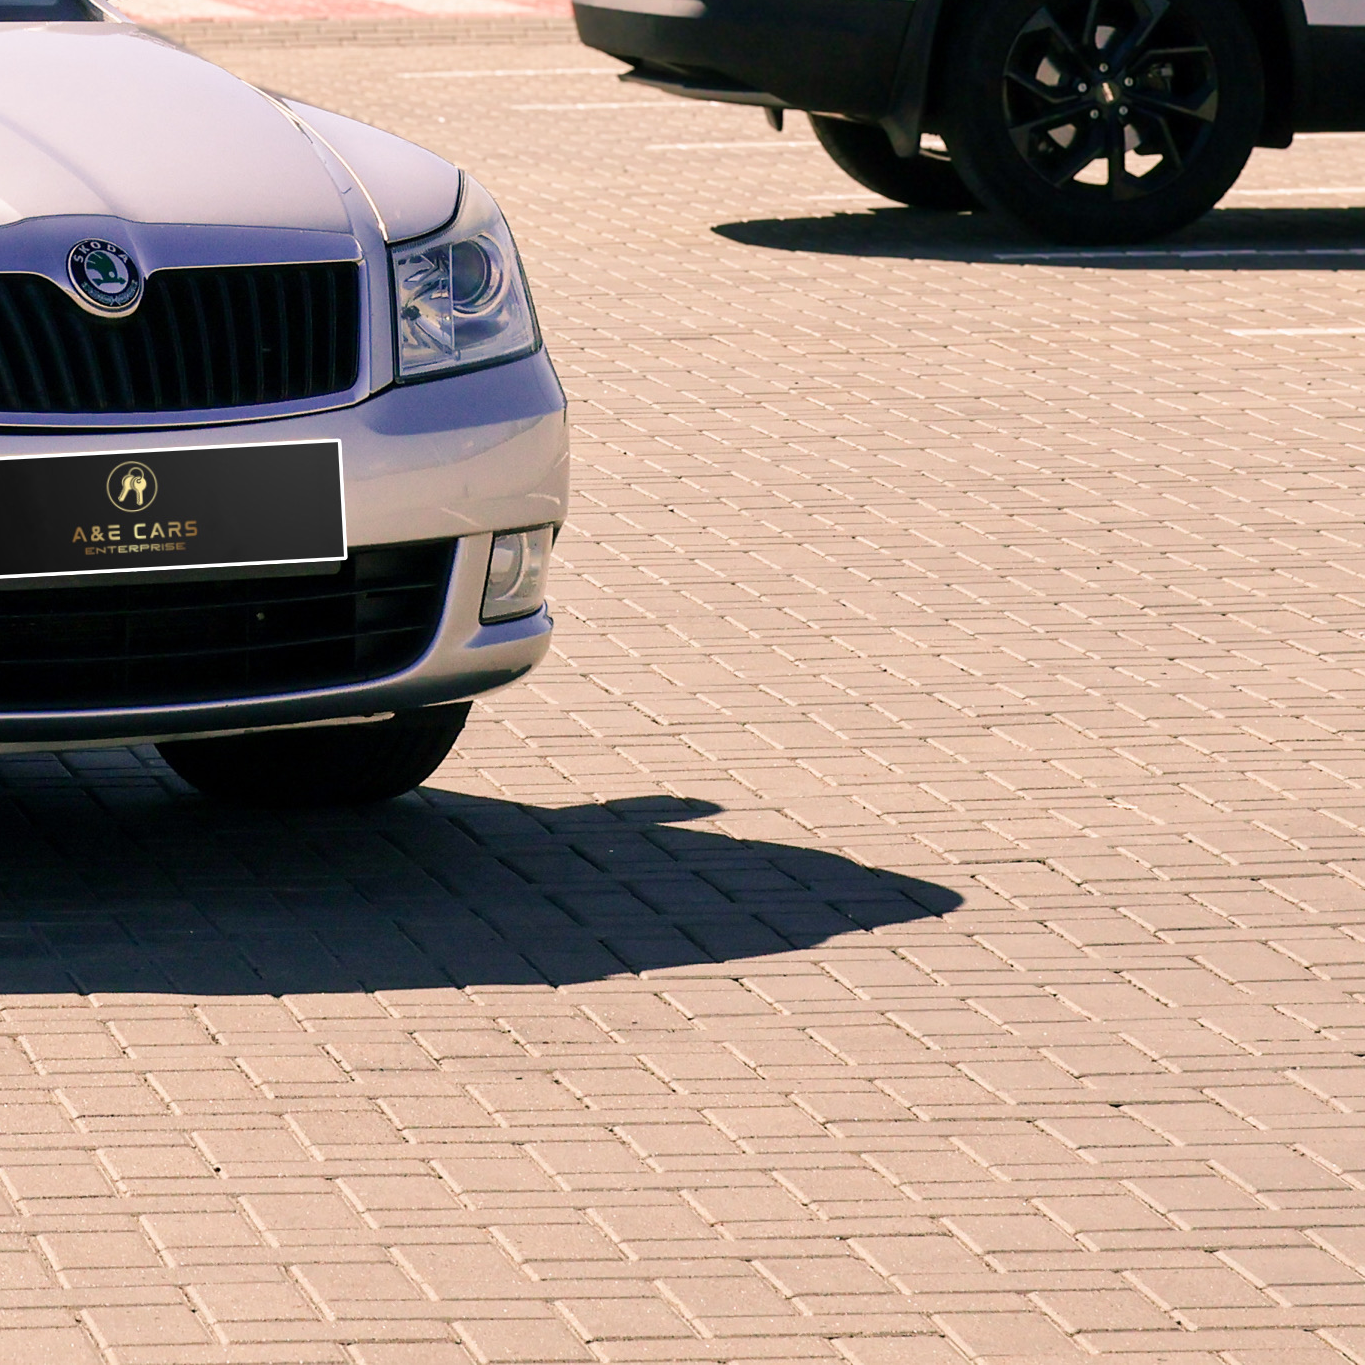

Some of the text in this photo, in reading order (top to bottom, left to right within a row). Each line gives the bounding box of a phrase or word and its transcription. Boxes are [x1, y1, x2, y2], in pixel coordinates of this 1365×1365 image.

[72, 520, 198, 543] A&E CARS
[85, 542, 187, 555] ENTERPRISE
